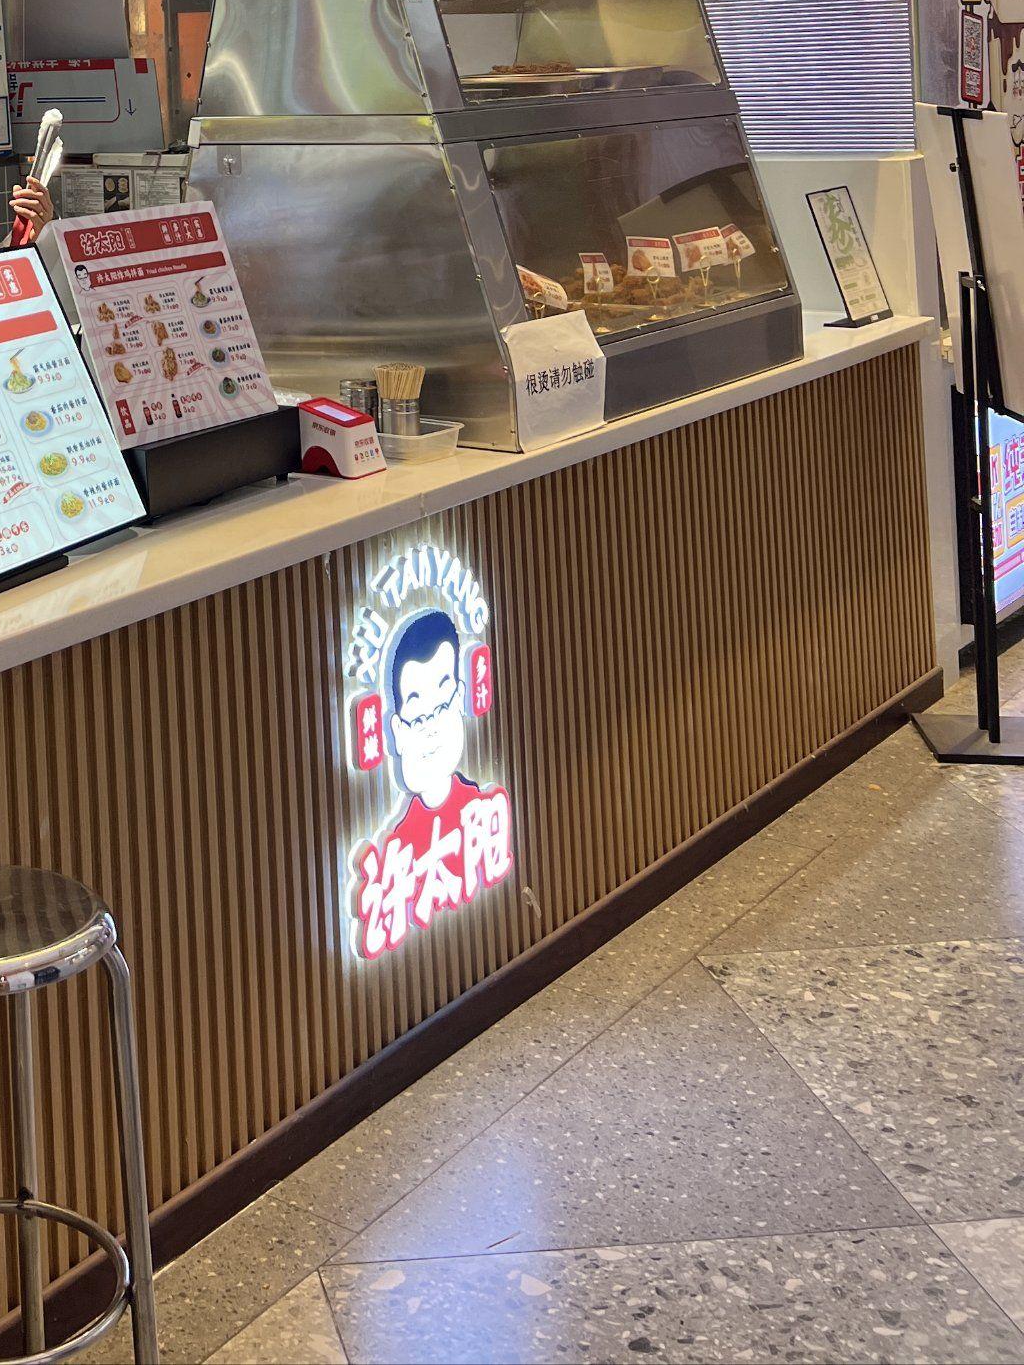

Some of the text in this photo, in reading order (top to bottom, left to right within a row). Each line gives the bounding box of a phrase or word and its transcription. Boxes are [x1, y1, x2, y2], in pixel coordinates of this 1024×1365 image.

[79, 229, 125, 256] 许太阳
[526, 358, 595, 396] 很烫请勿触碰
[353, 545, 489, 683] XU TAI YANG
[475, 654, 488, 709] 多汁
[362, 704, 379, 762] 鲜嫩
[361, 791, 512, 955] 许太阳
